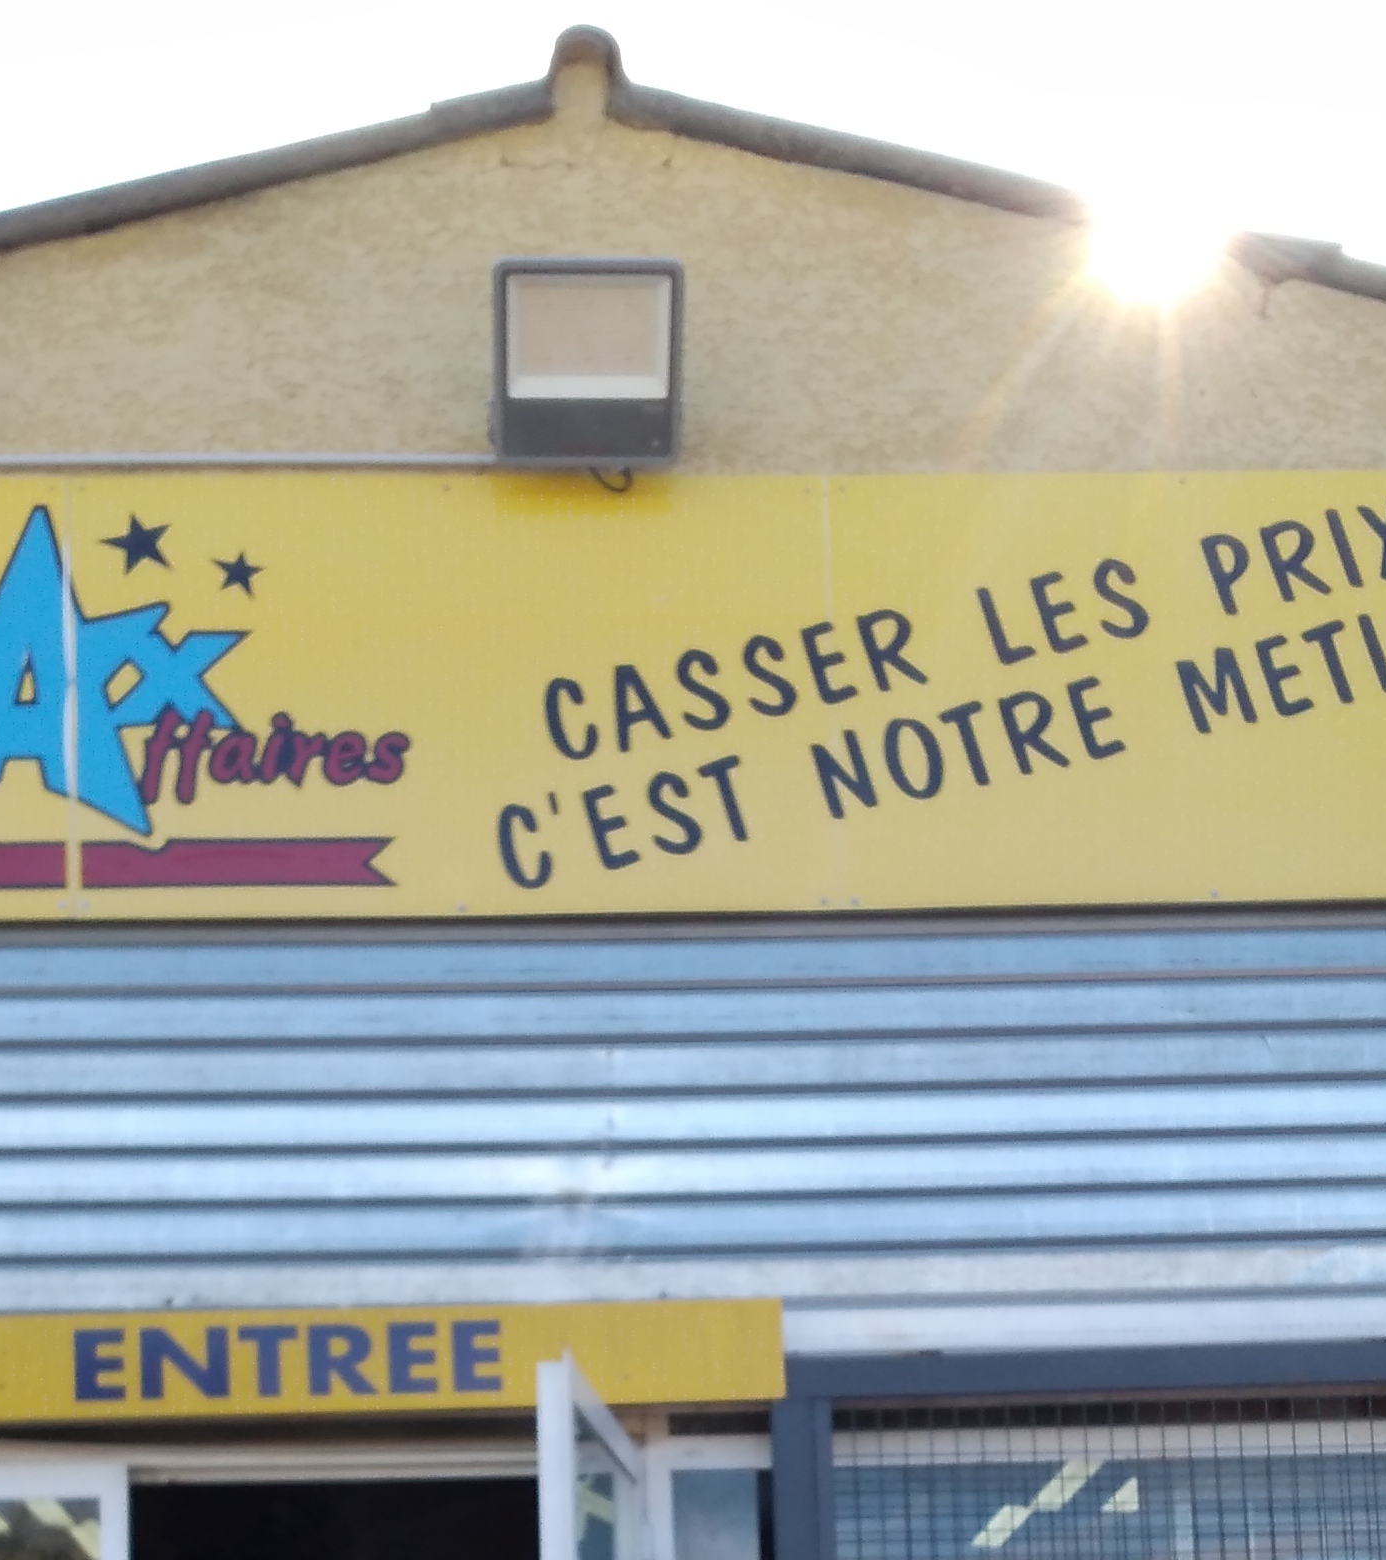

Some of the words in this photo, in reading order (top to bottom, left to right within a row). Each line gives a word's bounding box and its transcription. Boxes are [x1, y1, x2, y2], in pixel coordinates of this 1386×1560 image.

[544, 609, 928, 762] CASSER
[977, 558, 1150, 666] LES
[497, 755, 749, 890] C'EST
[811, 676, 1126, 820] NOTRE
[73, 1319, 503, 1401] ENTREE
